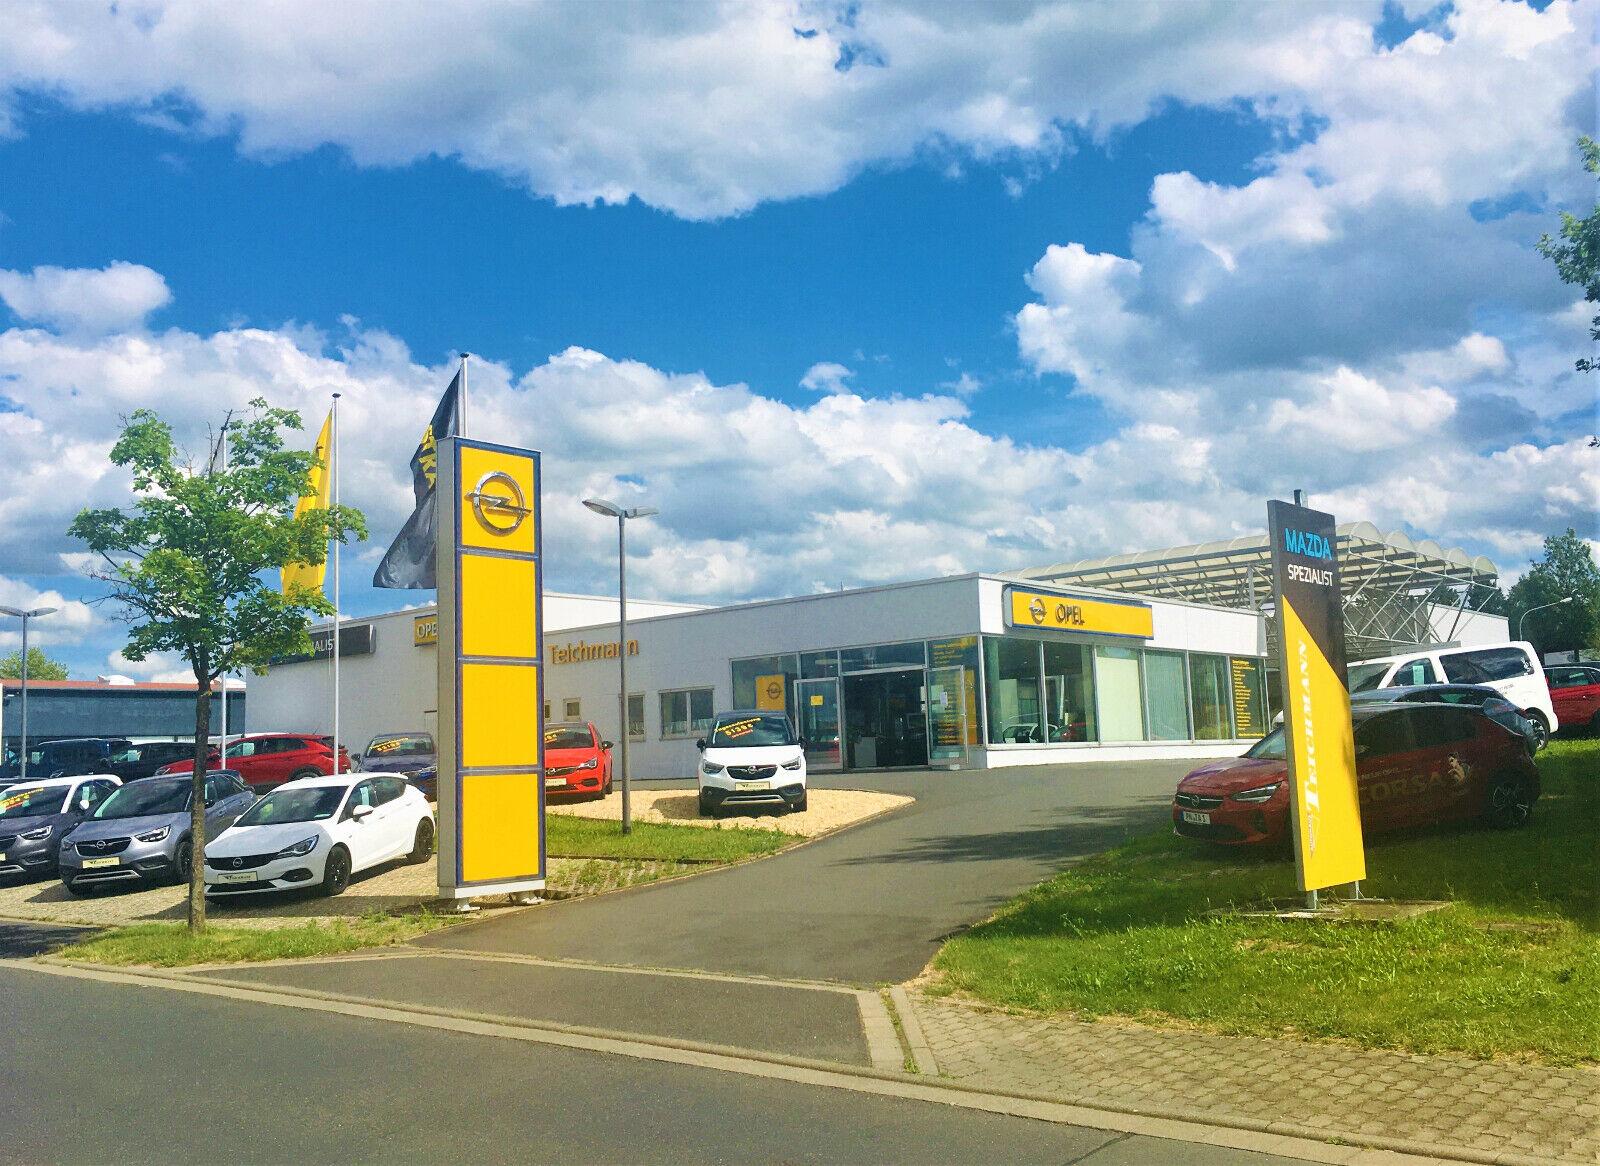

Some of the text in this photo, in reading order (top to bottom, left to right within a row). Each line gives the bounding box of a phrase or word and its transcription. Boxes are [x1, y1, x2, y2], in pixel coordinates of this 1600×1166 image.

[1284, 527, 1333, 561] MAZDA
[1287, 563, 1333, 587] SPEZIALIST
[1055, 603, 1085, 626] OPEL
[547, 640, 640, 664] Teichmann
[1298, 639, 1320, 812] TEICHMANN
